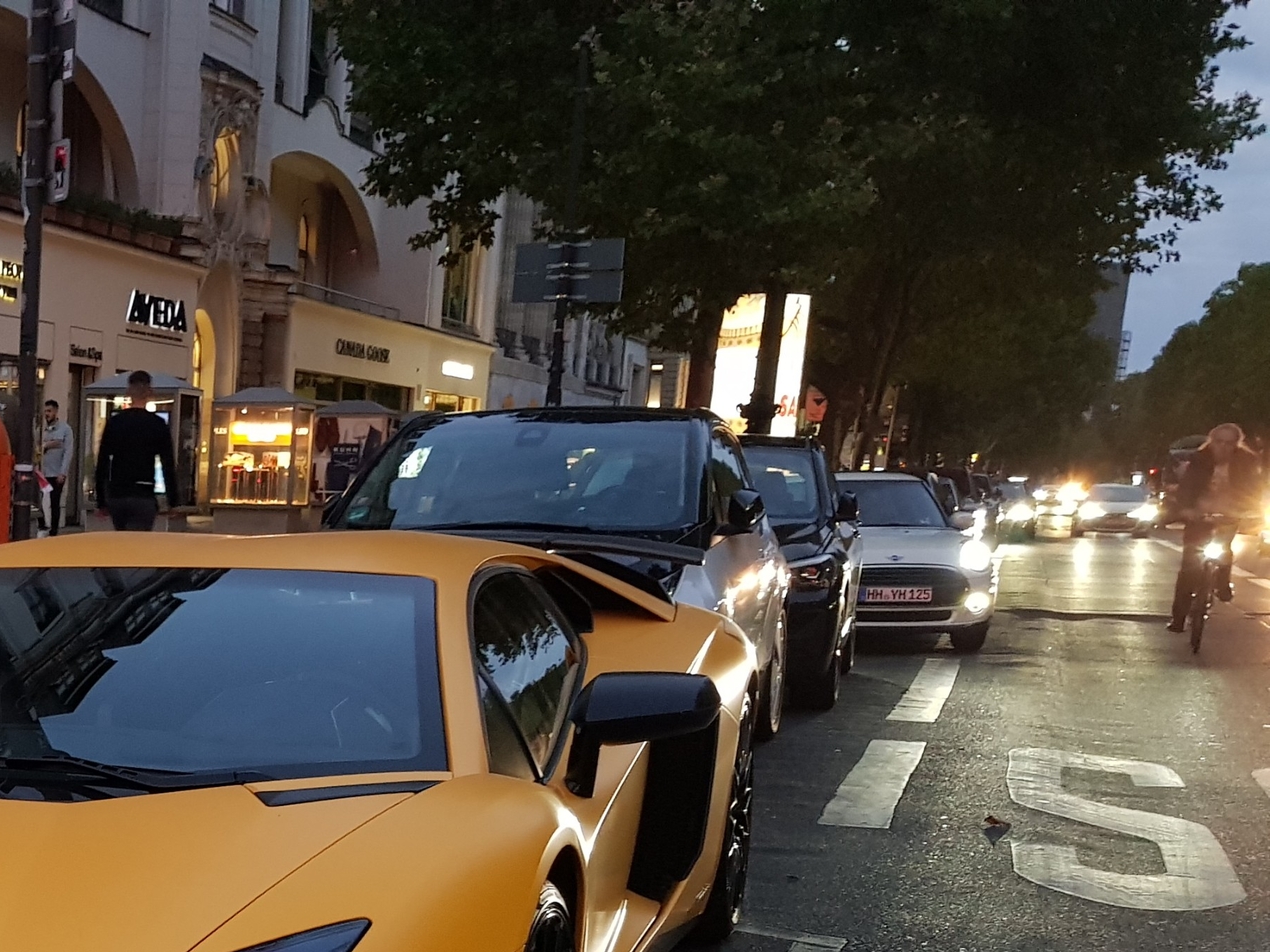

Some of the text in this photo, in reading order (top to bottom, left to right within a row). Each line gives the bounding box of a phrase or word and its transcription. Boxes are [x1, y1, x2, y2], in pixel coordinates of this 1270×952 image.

[1, 259, 25, 281] PEOP
[126, 288, 187, 333] AVEDA
[336, 338, 391, 364] CANADA GOOSE
[867, 589, 930, 600] HH YH 125
